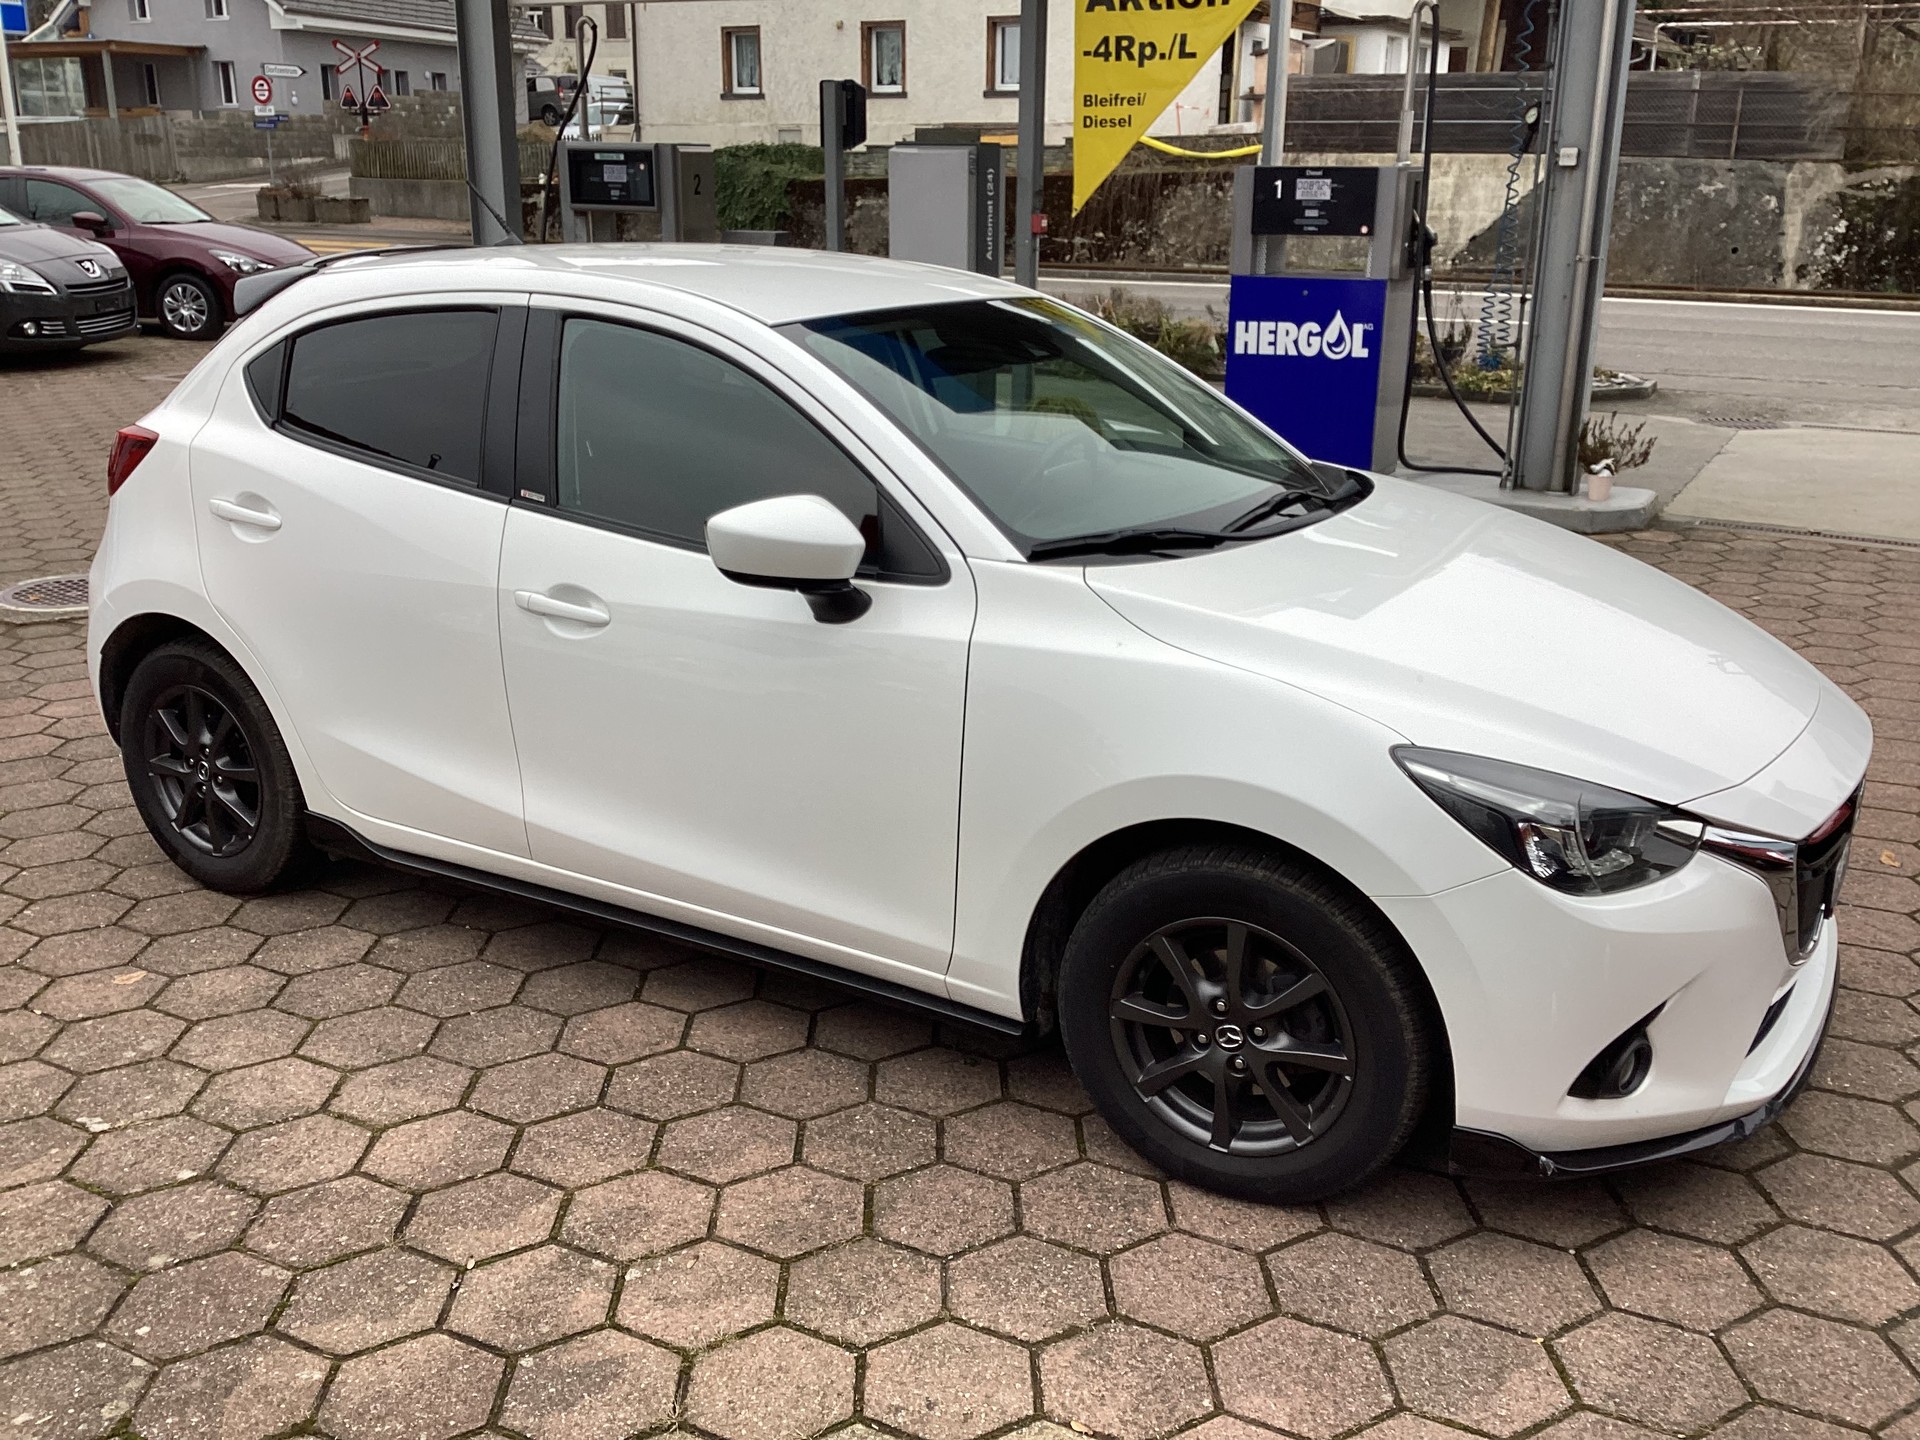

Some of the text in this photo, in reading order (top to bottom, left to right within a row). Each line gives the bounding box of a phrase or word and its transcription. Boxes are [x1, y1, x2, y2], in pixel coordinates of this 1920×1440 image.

[1082, 33, 1197, 68] -4Rp./L
[1082, 92, 1147, 108] Bleifrei/
[1082, 115, 1132, 129] Diesel
[693, 174, 701, 196] 2
[1273, 179, 1283, 199] 1
[986, 168, 995, 260] Automat (24)
